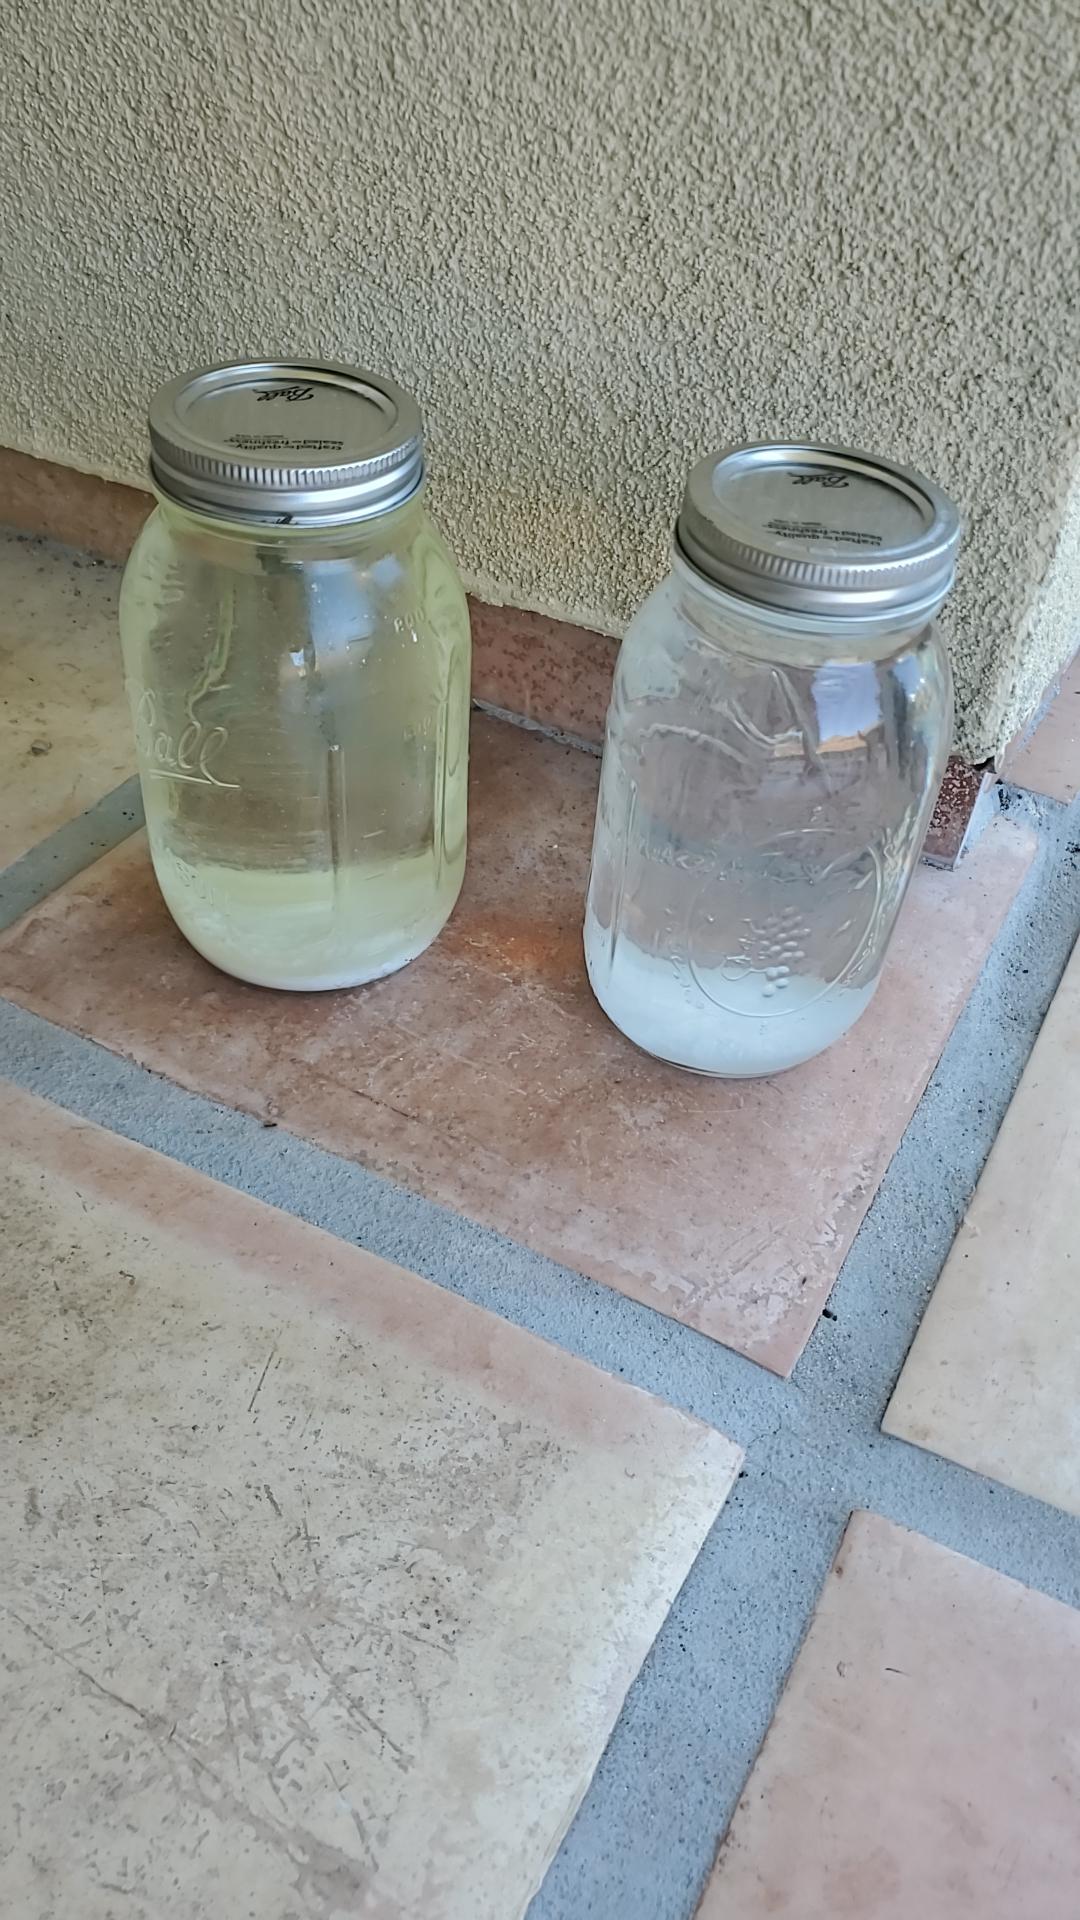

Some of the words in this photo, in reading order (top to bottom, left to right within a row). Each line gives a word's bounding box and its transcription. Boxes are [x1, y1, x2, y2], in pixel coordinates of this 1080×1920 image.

[252, 385, 315, 402] Ball
[235, 443, 282, 451] quality
[787, 472, 850, 489] Ball
